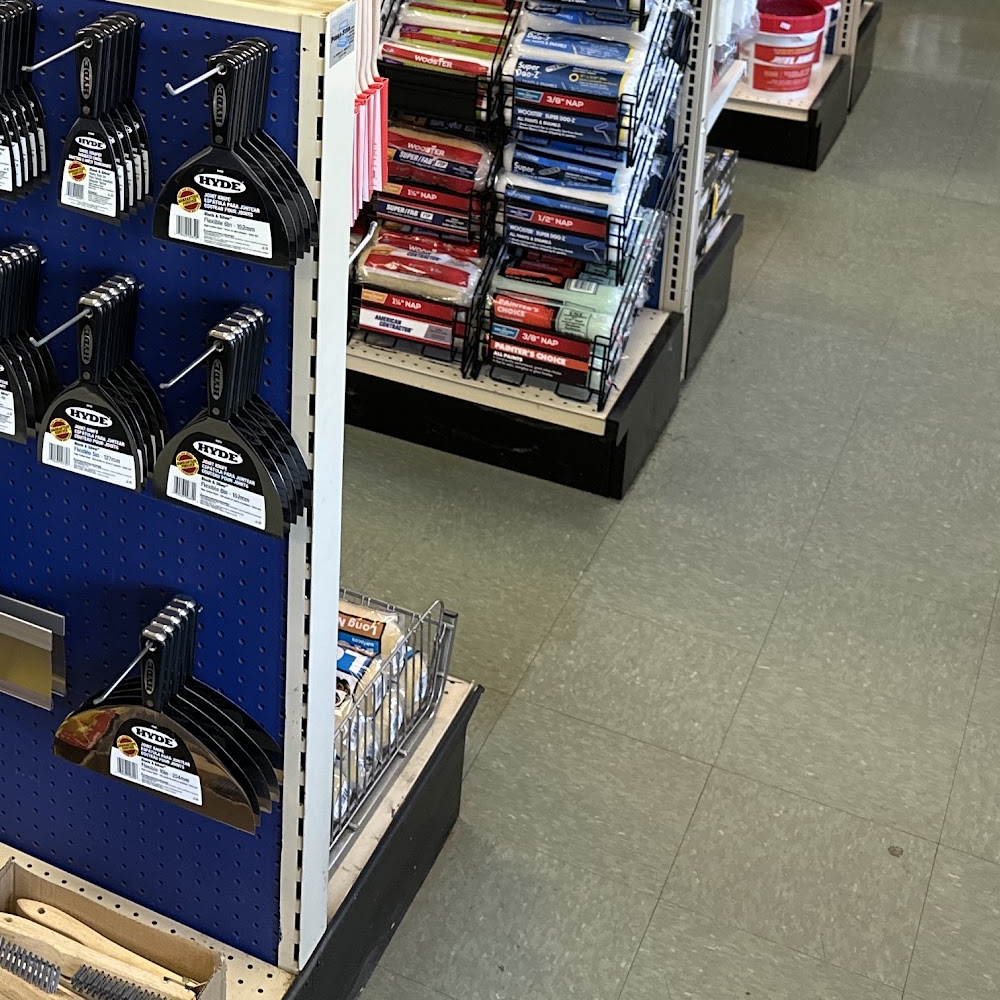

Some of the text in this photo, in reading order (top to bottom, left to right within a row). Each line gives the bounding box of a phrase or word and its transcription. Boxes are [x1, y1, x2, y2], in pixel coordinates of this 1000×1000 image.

[414, 55, 453, 69] WOOSTER
[518, 61, 540, 72] Super
[83, 60, 91, 96] HYDE
[515, 69, 540, 79] Doo-Z
[565, 99, 584, 108] NAP
[78, 137, 105, 148] HYDE
[407, 142, 445, 156] WOOSTER
[199, 175, 243, 191] HYDE
[421, 191, 437, 200] NAP
[555, 218, 573, 227] NAP
[405, 300, 421, 309] NAP
[497, 306, 526, 317] CHOICE
[375, 315, 402, 325] AMERICAN
[379, 321, 412, 333] CONTRACTOR
[541, 337, 559, 346] NAP
[494, 341, 567, 366] PAINTER'S CHOICE
[213, 361, 221, 397] HYDE
[70, 408, 109, 425] HYDE
[198, 443, 238, 462] HYDE
[347, 617, 380, 636] Long
[136, 728, 176, 747] HYDE
